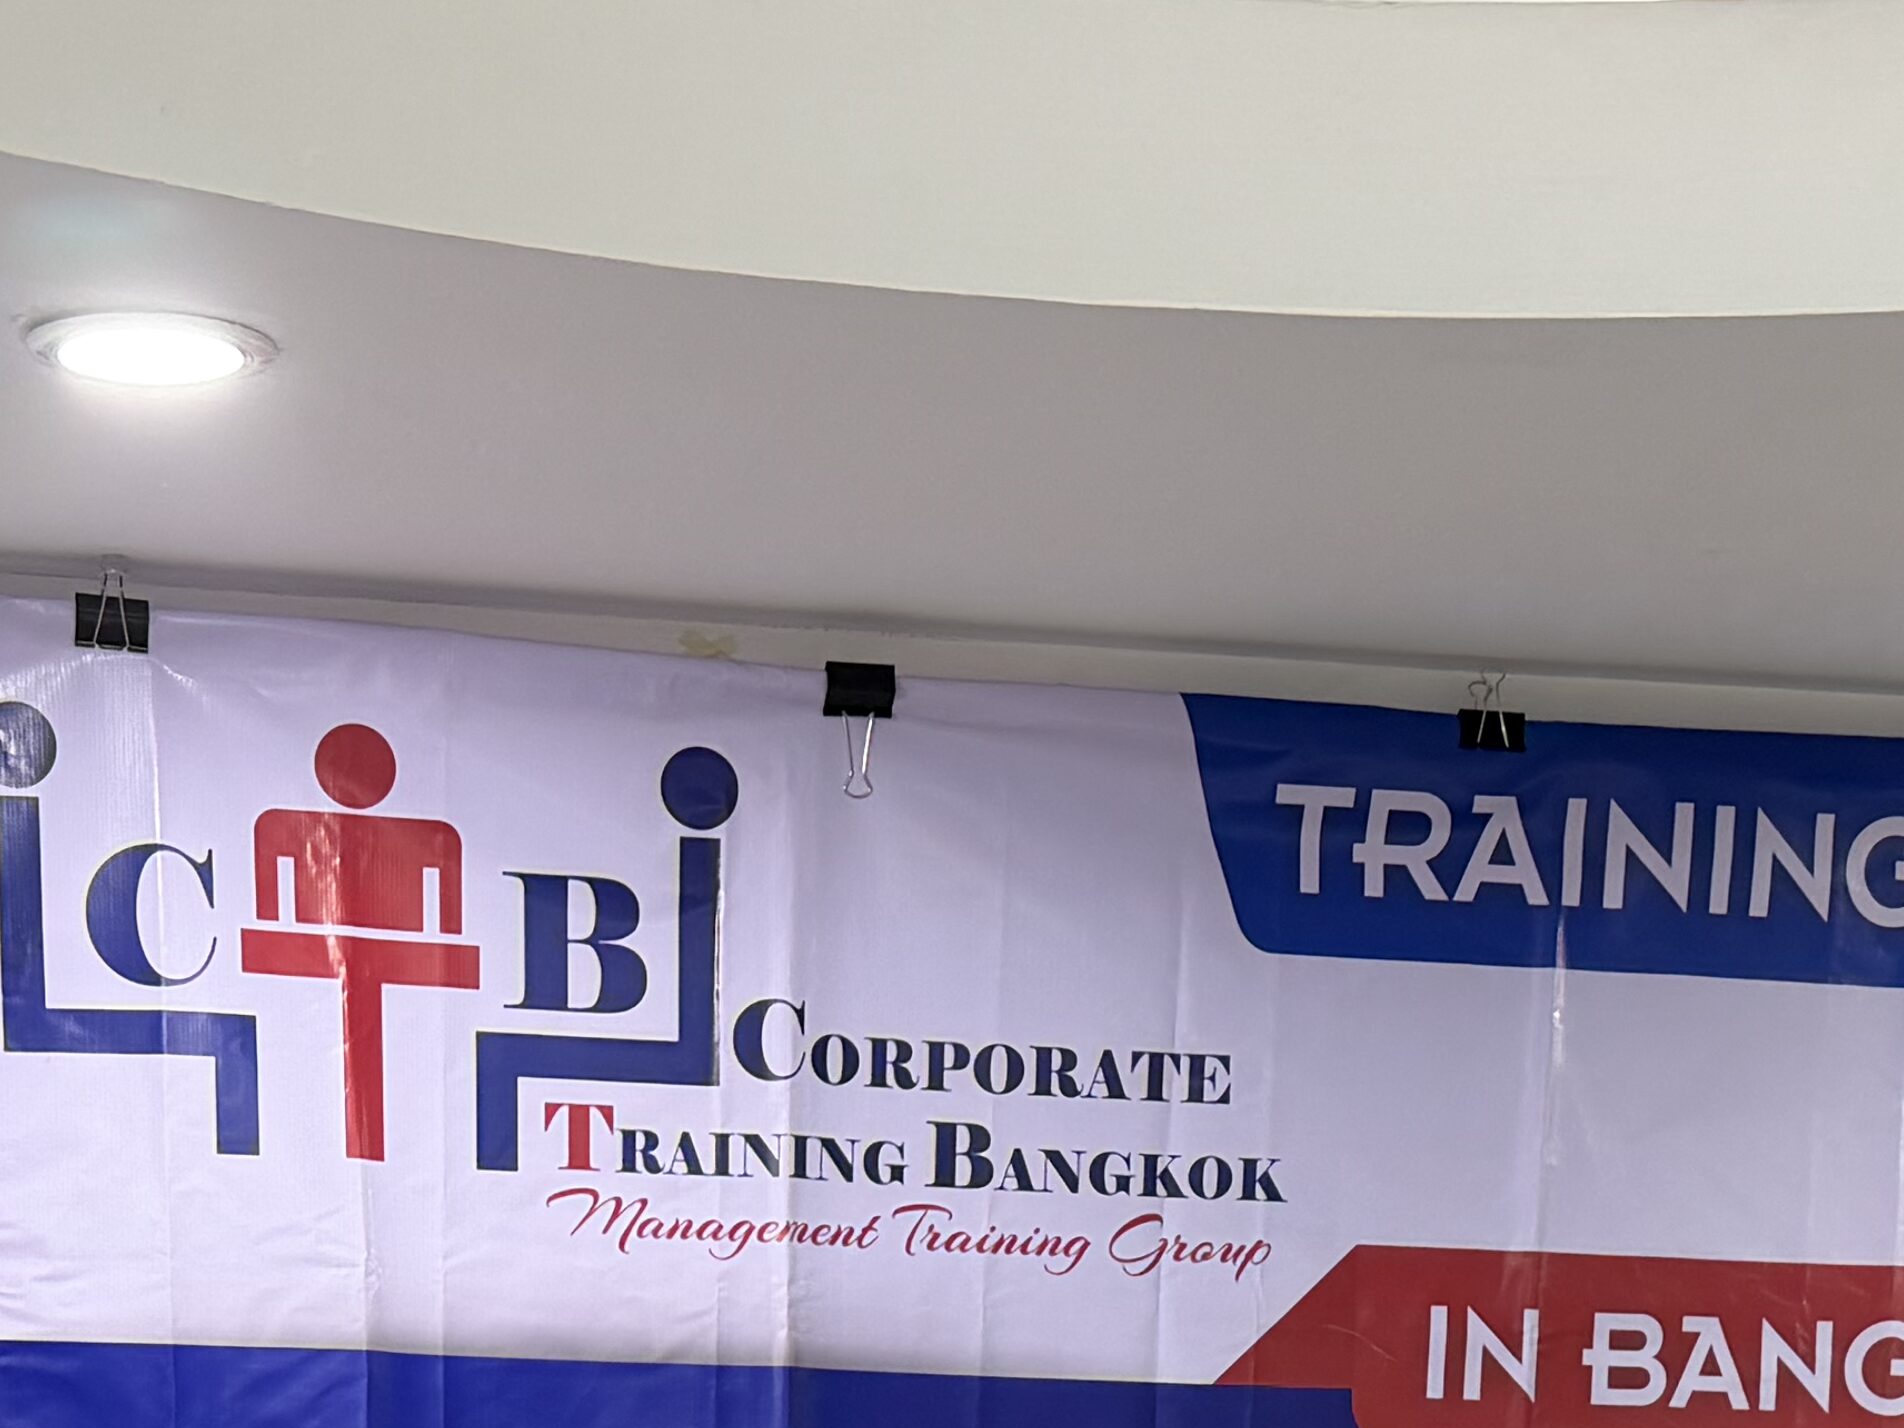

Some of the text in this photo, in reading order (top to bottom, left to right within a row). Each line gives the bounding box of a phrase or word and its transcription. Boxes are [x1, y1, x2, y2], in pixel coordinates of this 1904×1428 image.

[732, 997, 1232, 1108] CORPORATE
[544, 1100, 1288, 1204] TRAINING BANGKOK
[545, 1187, 1274, 1283] Management Training Group
[1424, 1306, 1540, 1402] IN
